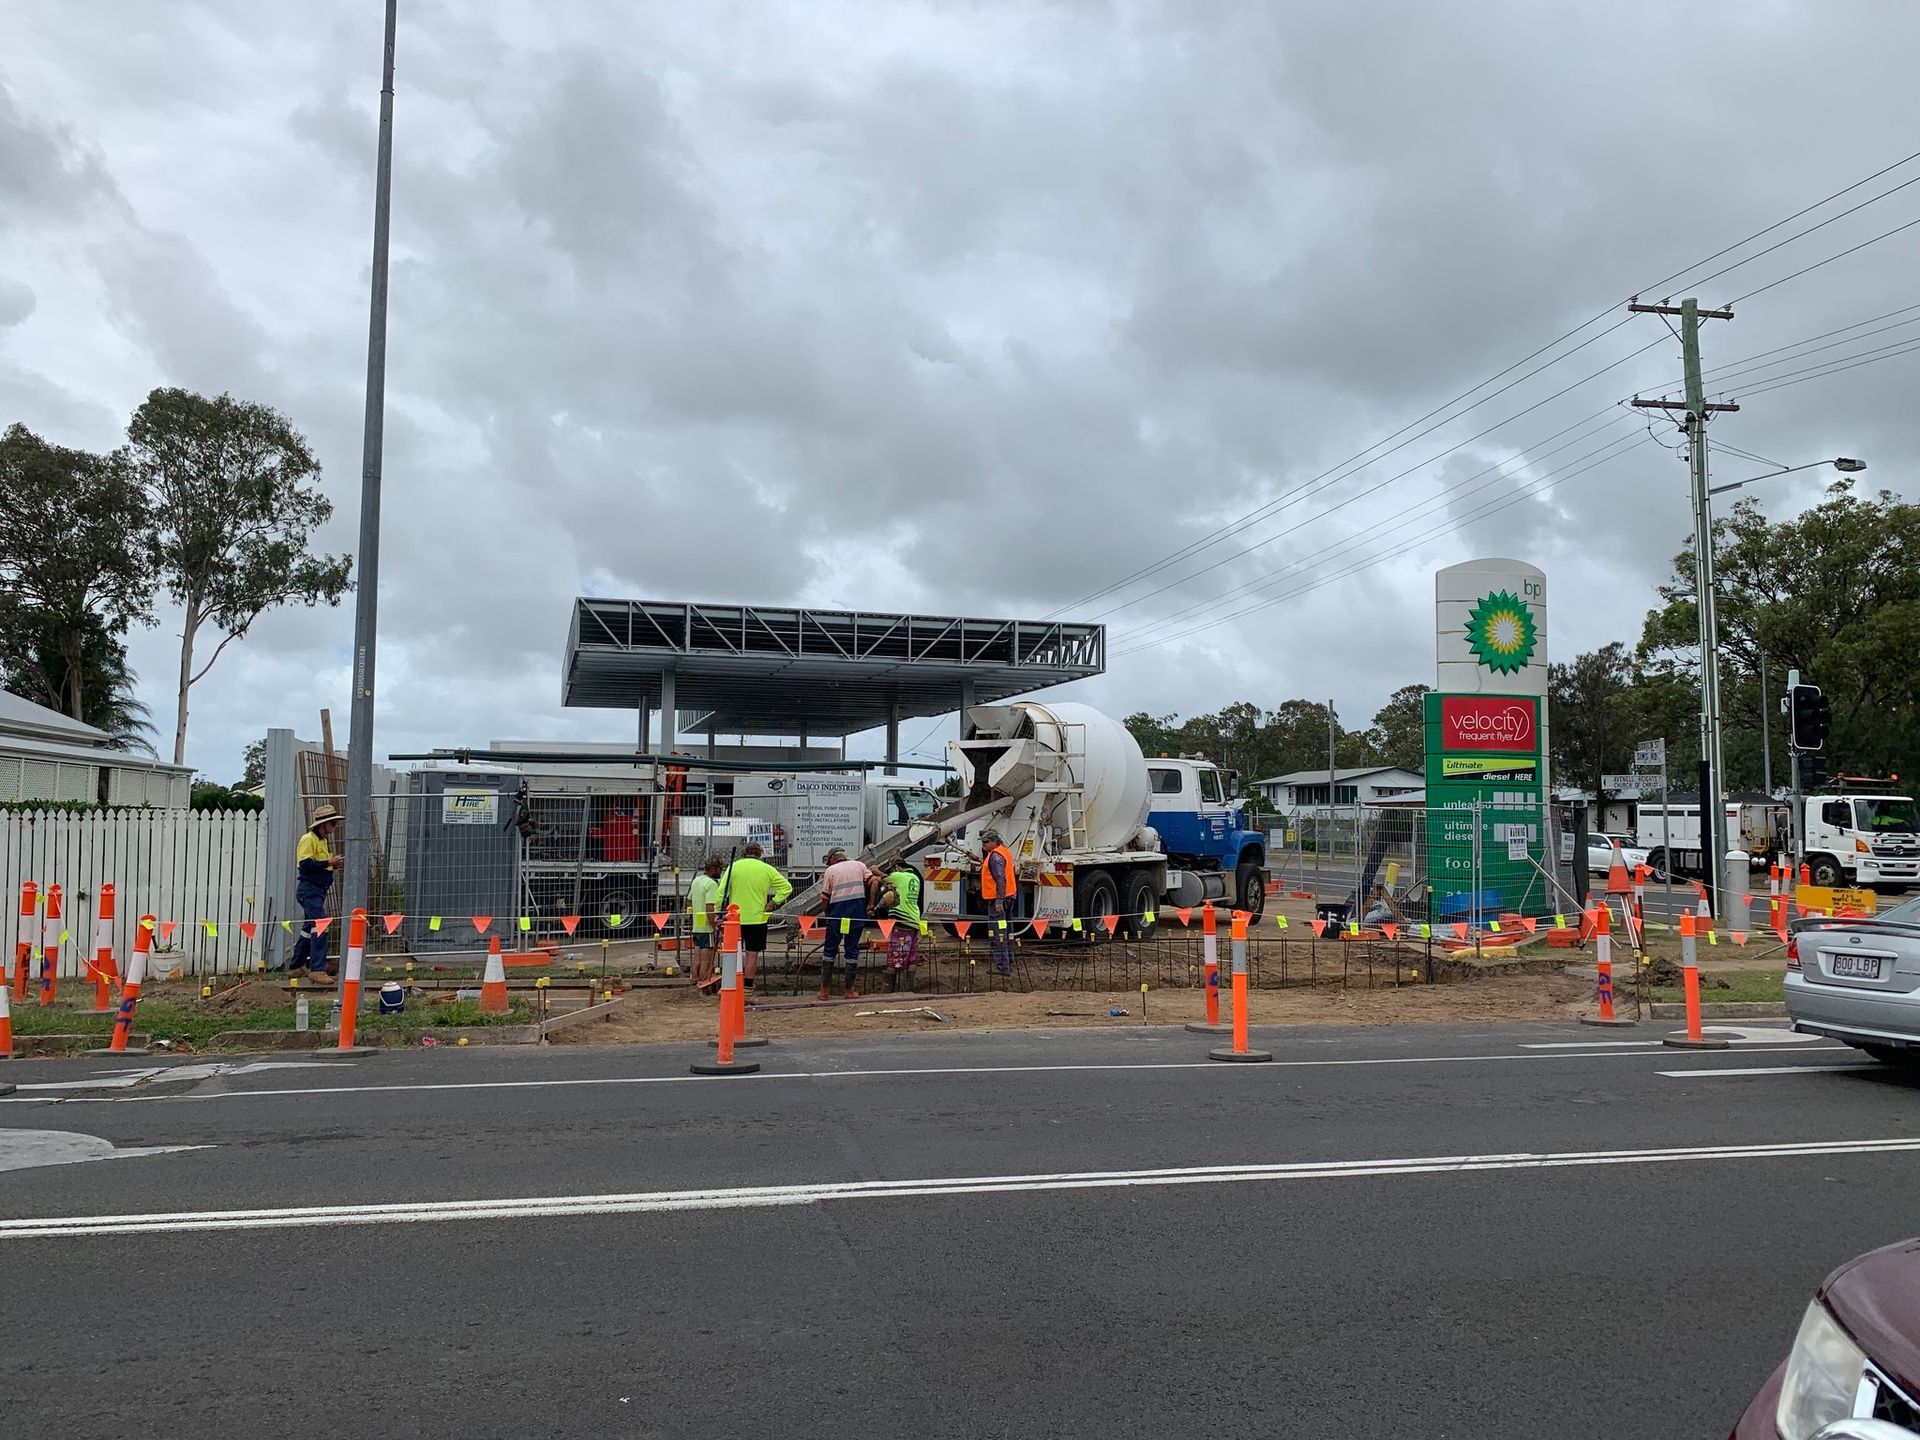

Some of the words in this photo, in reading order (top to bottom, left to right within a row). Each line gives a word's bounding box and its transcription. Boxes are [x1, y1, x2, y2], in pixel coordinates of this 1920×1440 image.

[1524, 578, 1541, 600] bp
[1450, 709, 1525, 740] velocity
[1459, 731, 1495, 741] frequent
[1496, 731, 1514, 742] flyer
[1636, 752, 1649, 761] SIMS
[1447, 761, 1485, 770] ultimate
[1514, 773, 1533, 781] HERE
[1445, 821, 1488, 830] ultime
[1444, 831, 1474, 841] diese
